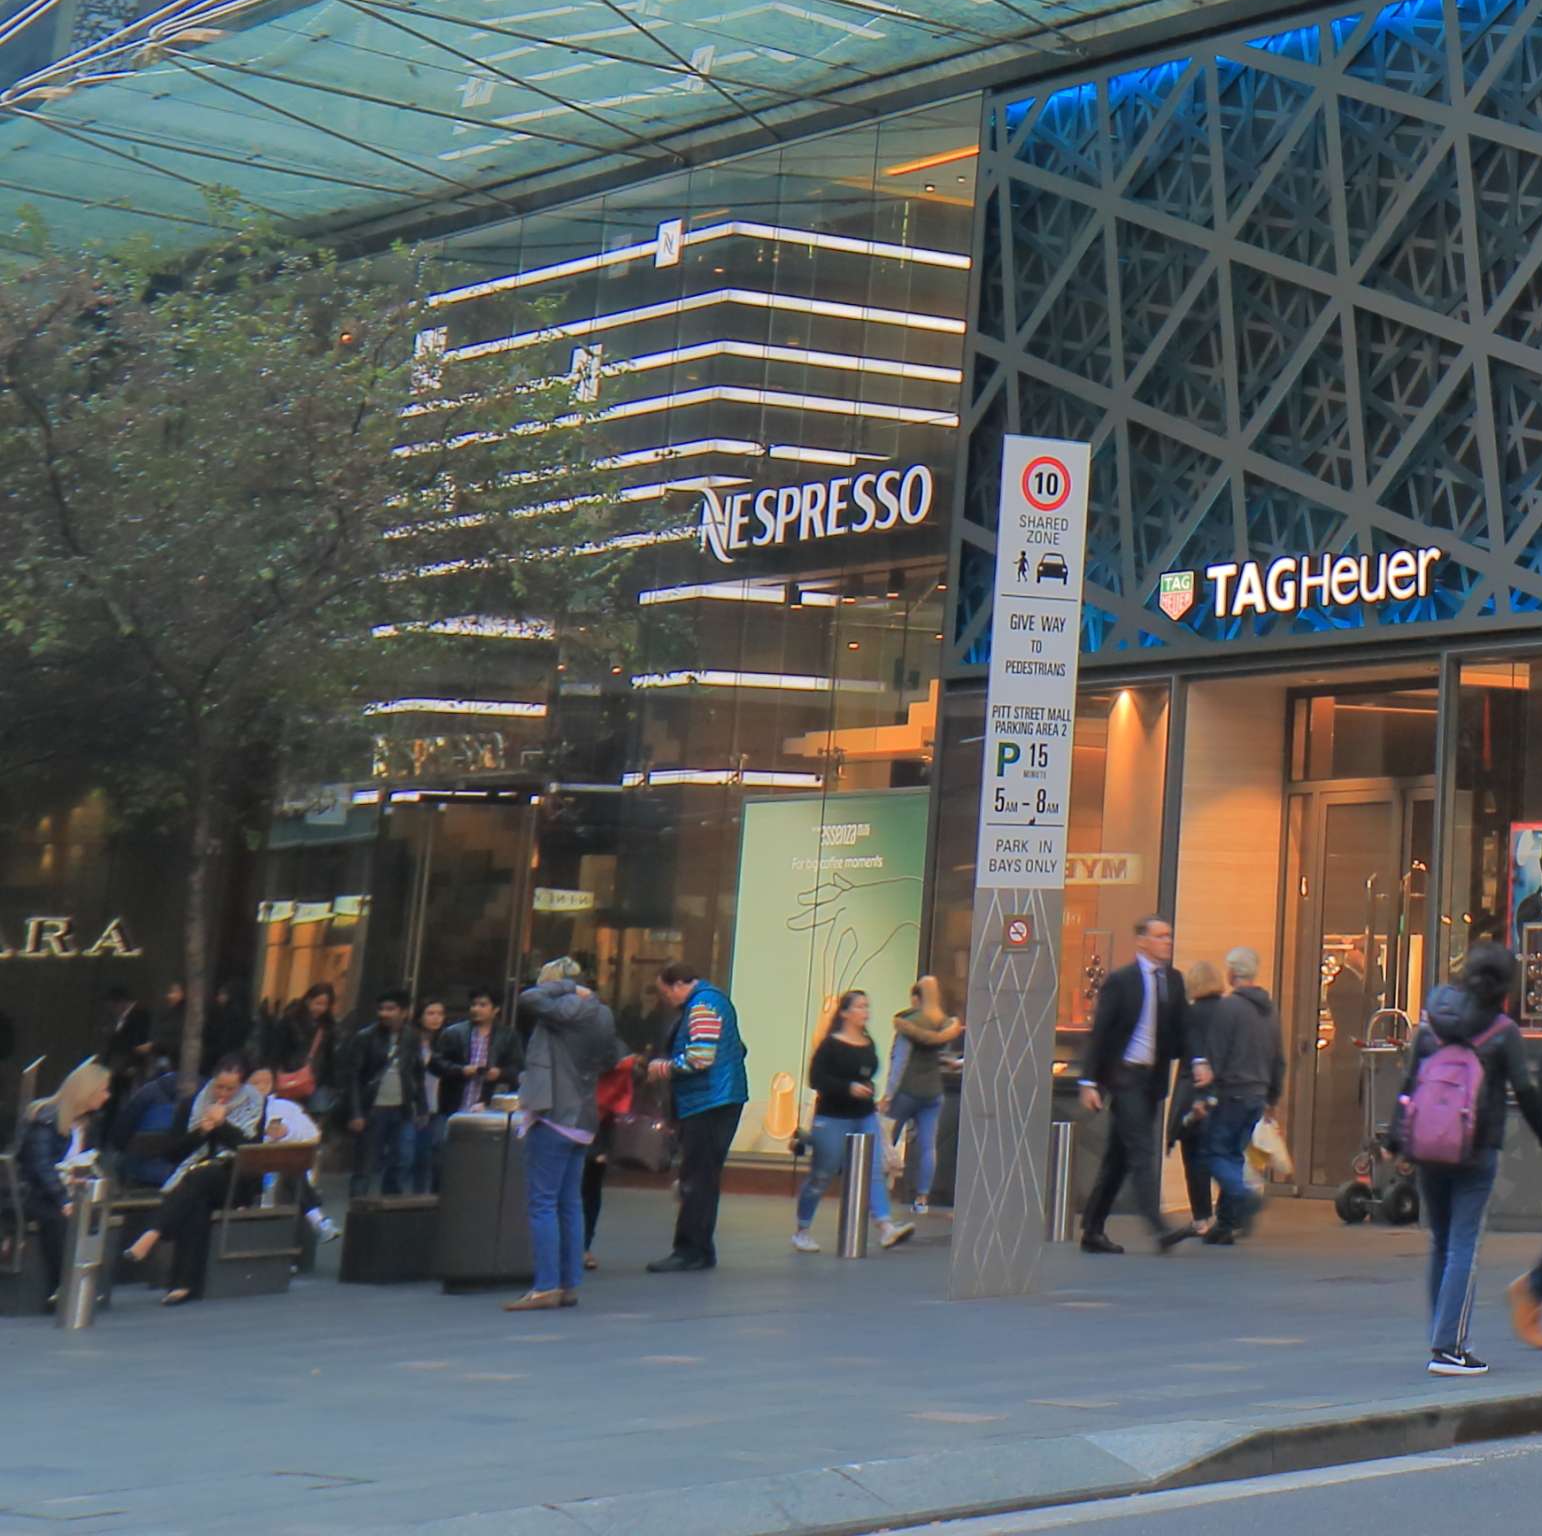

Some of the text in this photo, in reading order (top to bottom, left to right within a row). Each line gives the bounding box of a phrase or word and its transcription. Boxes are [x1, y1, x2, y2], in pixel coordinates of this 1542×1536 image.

[1034, 471, 1058, 496] 10
[701, 465, 933, 563] NESPRESSO
[1019, 514, 1069, 532] SHARED
[1026, 530, 1060, 545] ZONE
[1164, 575, 1190, 591] TAG
[1010, 614, 1066, 633] GIVE WAY
[1031, 639, 1043, 654] TO
[1005, 661, 1066, 677] PEDESTRIANS
[992, 704, 1072, 722] PITT STREET MALL
[995, 720, 1067, 737] PARKING AREA 2
[996, 742, 1049, 777] P 15
[1023, 770, 1047, 780] MINUTE
[995, 787, 1018, 814] 5AM
[1036, 788, 1060, 814] 8AM
[996, 839, 1052, 853] PARK IN
[989, 859, 1057, 873] BAYS ONLY
[0, 917, 143, 959] RA
